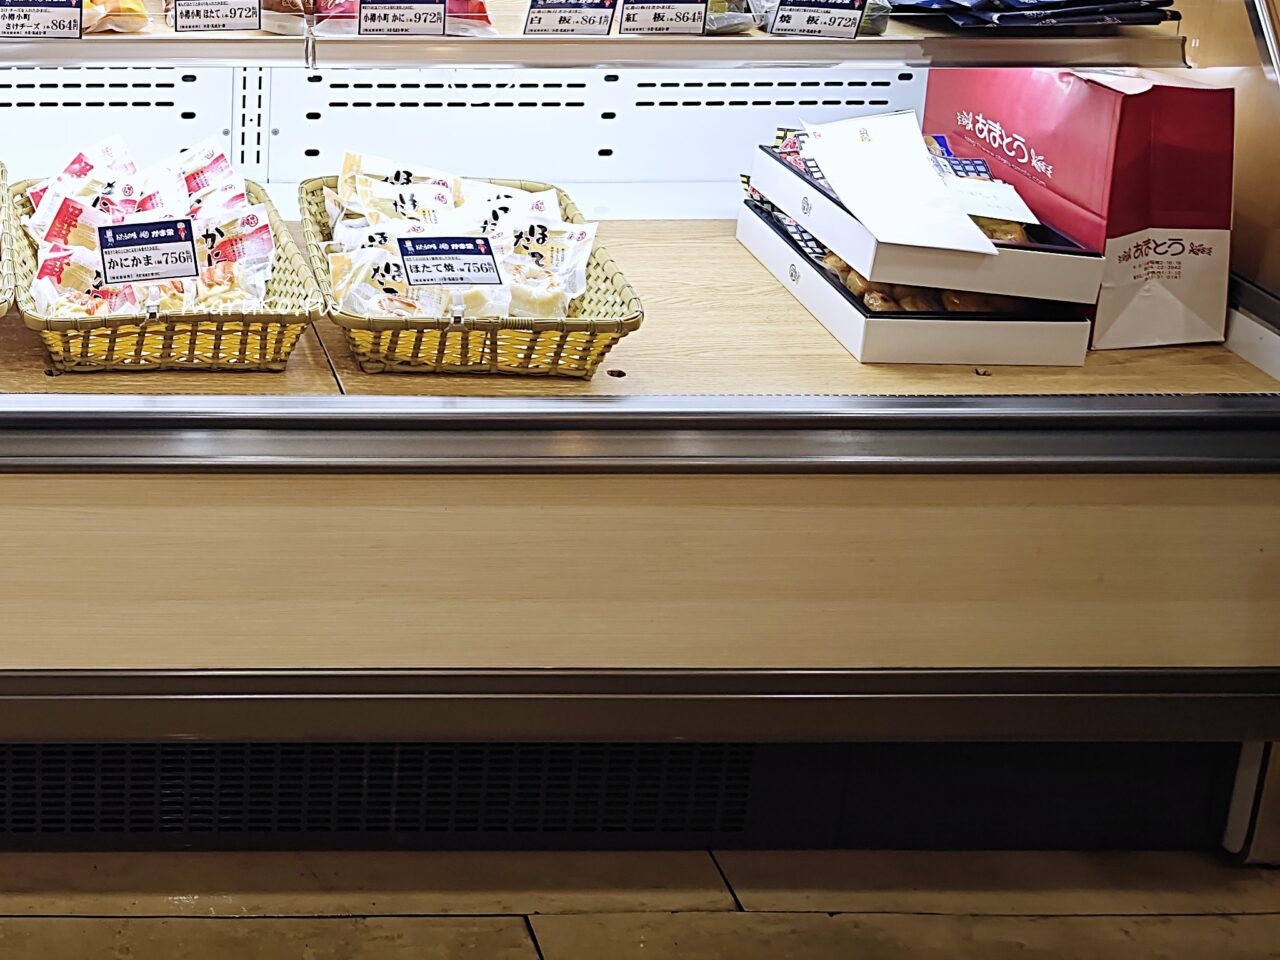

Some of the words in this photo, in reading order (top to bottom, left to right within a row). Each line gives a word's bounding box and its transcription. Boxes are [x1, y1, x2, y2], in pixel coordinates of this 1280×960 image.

[203, 8, 221, 18] ほたて
[975, 112, 1029, 163] あまとう
[108, 255, 153, 270] かにかま
[409, 263, 454, 274] ほたて焼
